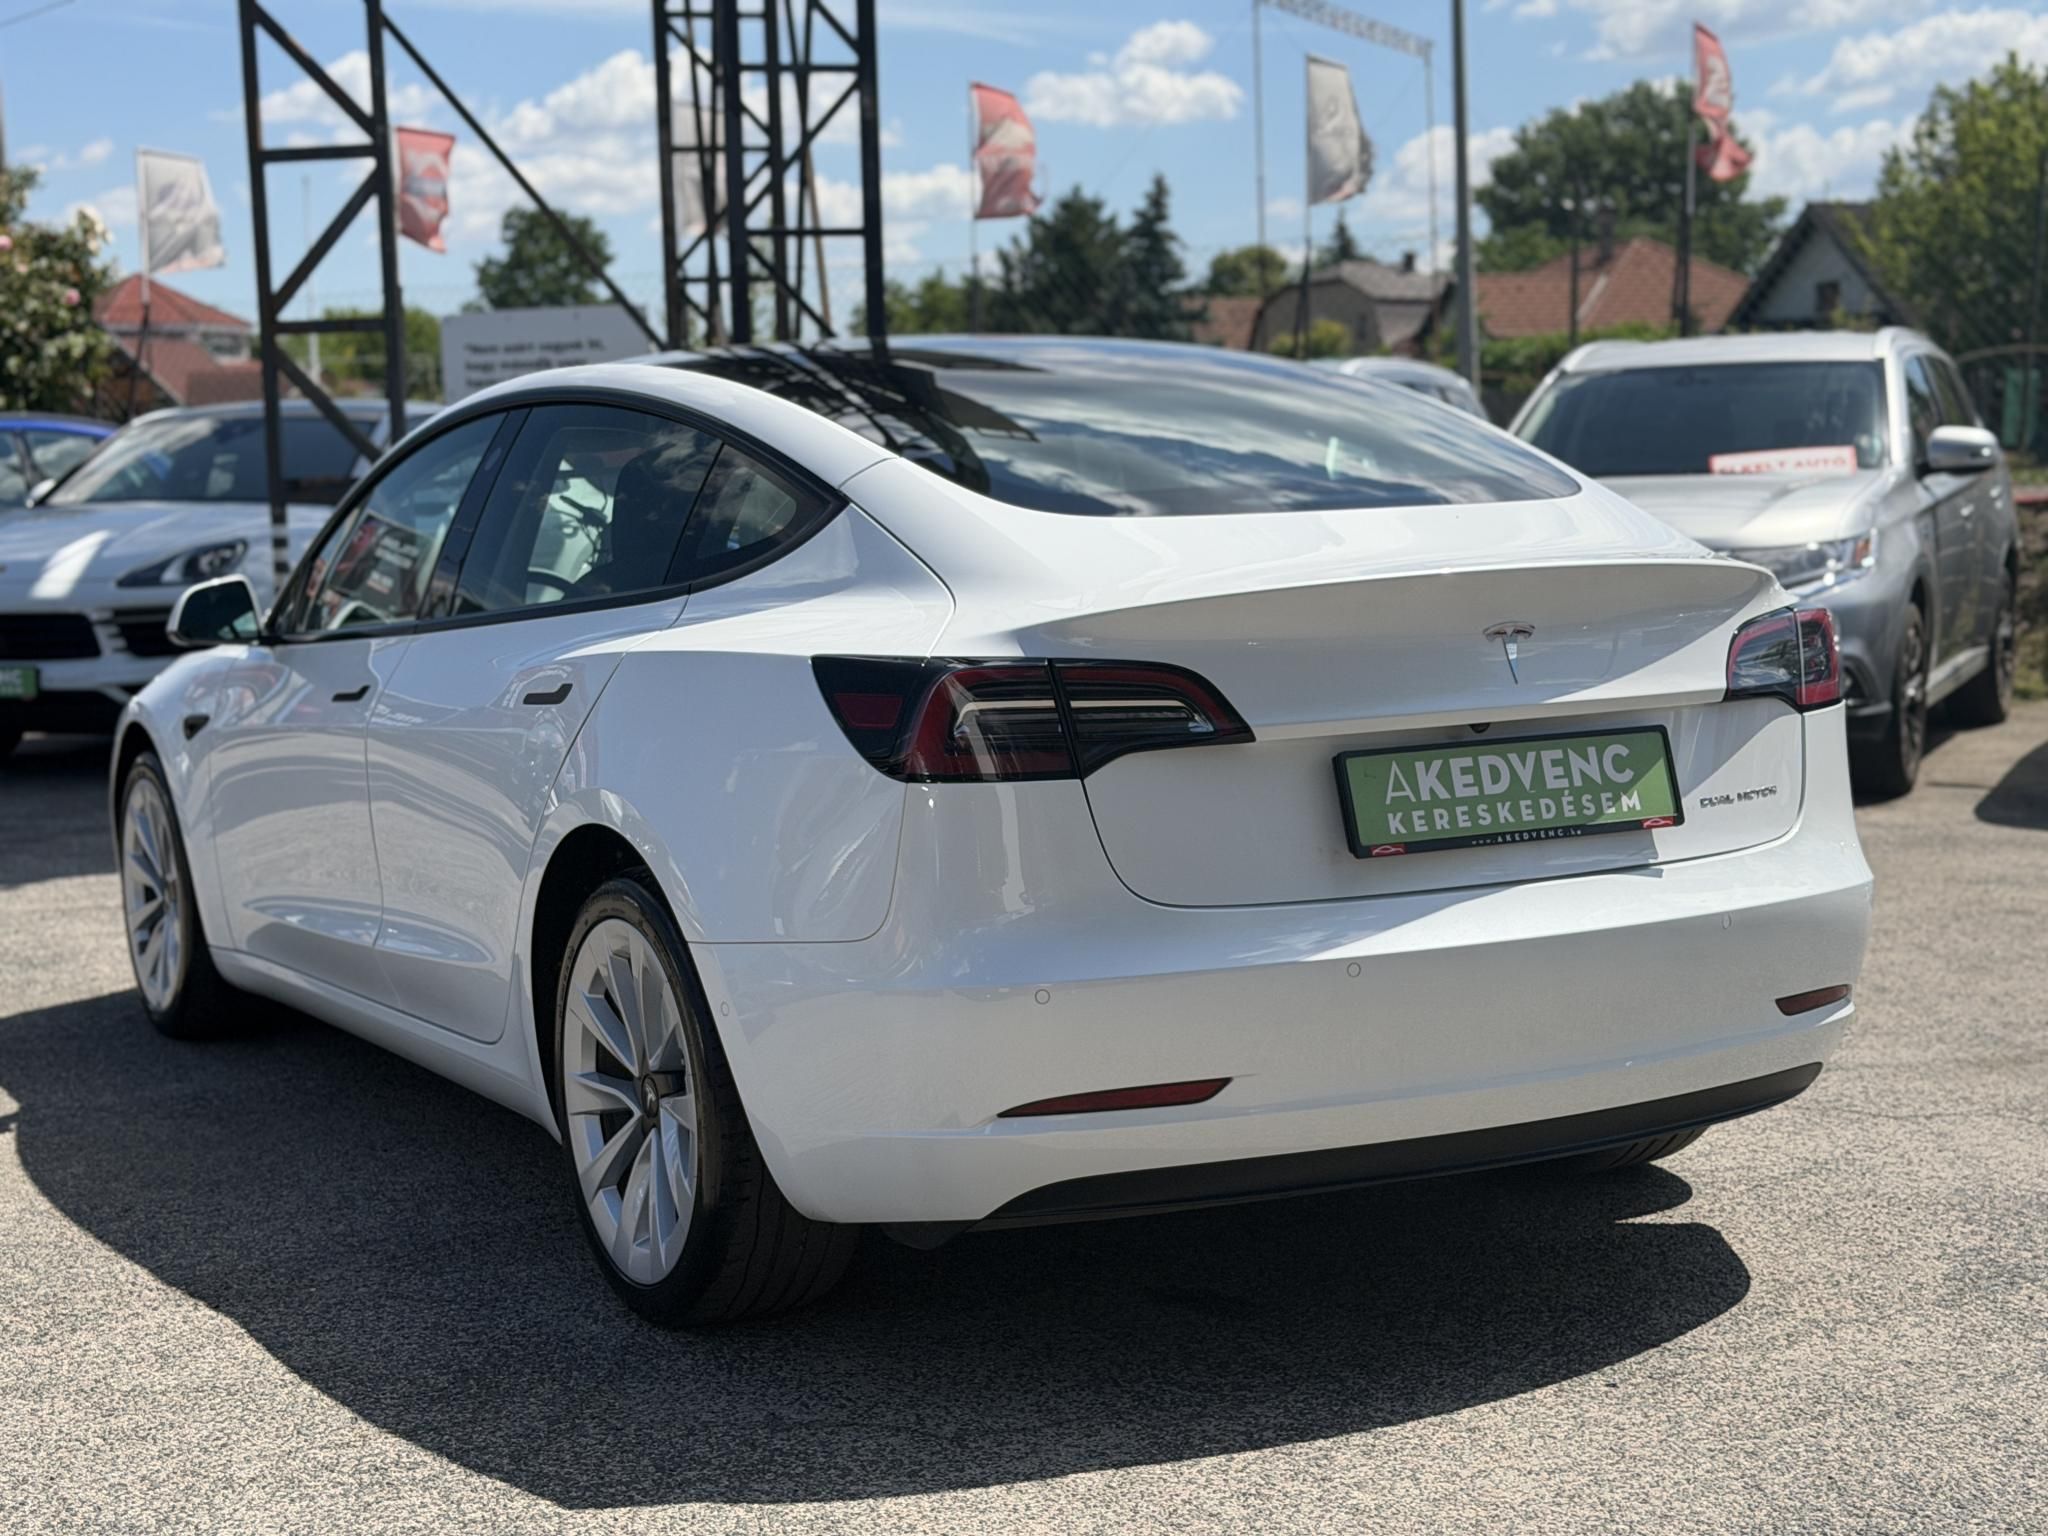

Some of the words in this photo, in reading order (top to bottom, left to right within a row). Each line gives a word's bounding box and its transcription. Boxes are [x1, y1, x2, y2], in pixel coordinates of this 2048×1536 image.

[1387, 789, 1642, 835] KERESKEDÉSEM
[1700, 794, 1735, 808] DUAL
[1736, 785, 1777, 803] MOTOR
